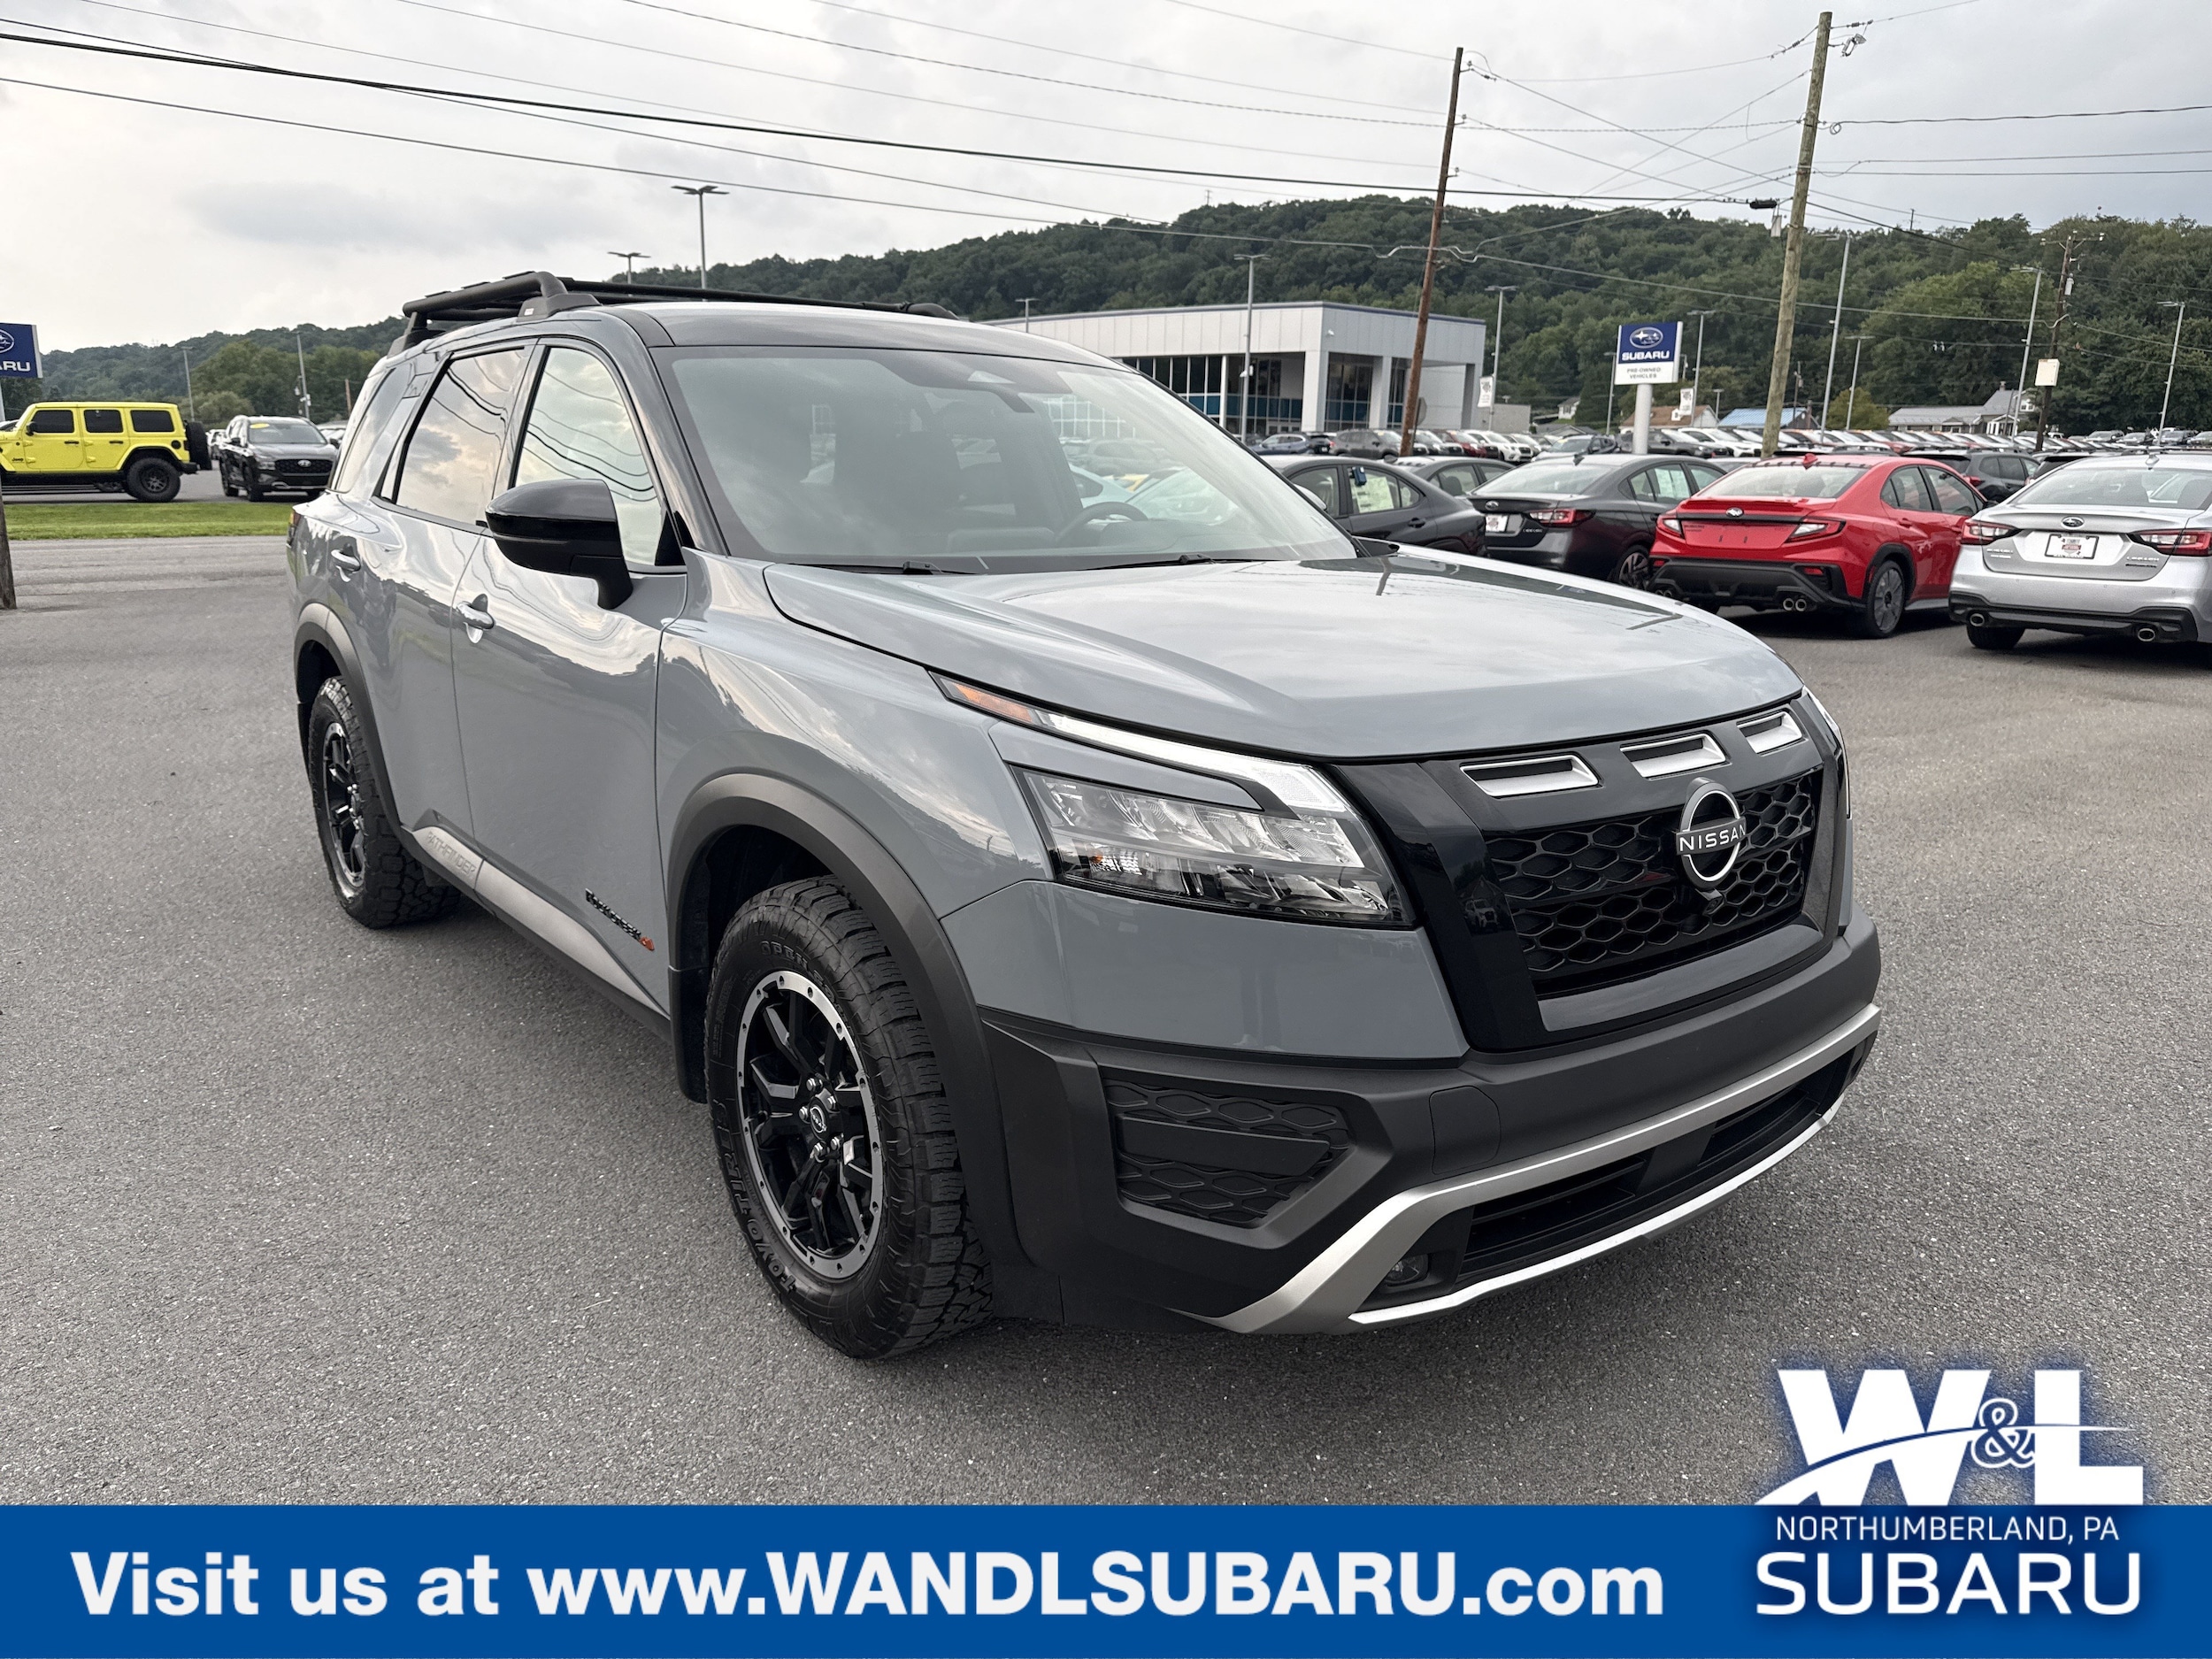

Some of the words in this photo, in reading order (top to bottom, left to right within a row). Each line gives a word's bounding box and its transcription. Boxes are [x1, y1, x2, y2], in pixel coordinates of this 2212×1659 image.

[1622, 350, 1670, 361] SUBARU
[426, 831, 477, 875] PATHFINDER
[1679, 824, 1746, 852] NISSAN
[760, 940, 809, 972] OPEN
[712, 1097, 751, 1216] TIRES
[746, 1218, 797, 1294] TOYO
